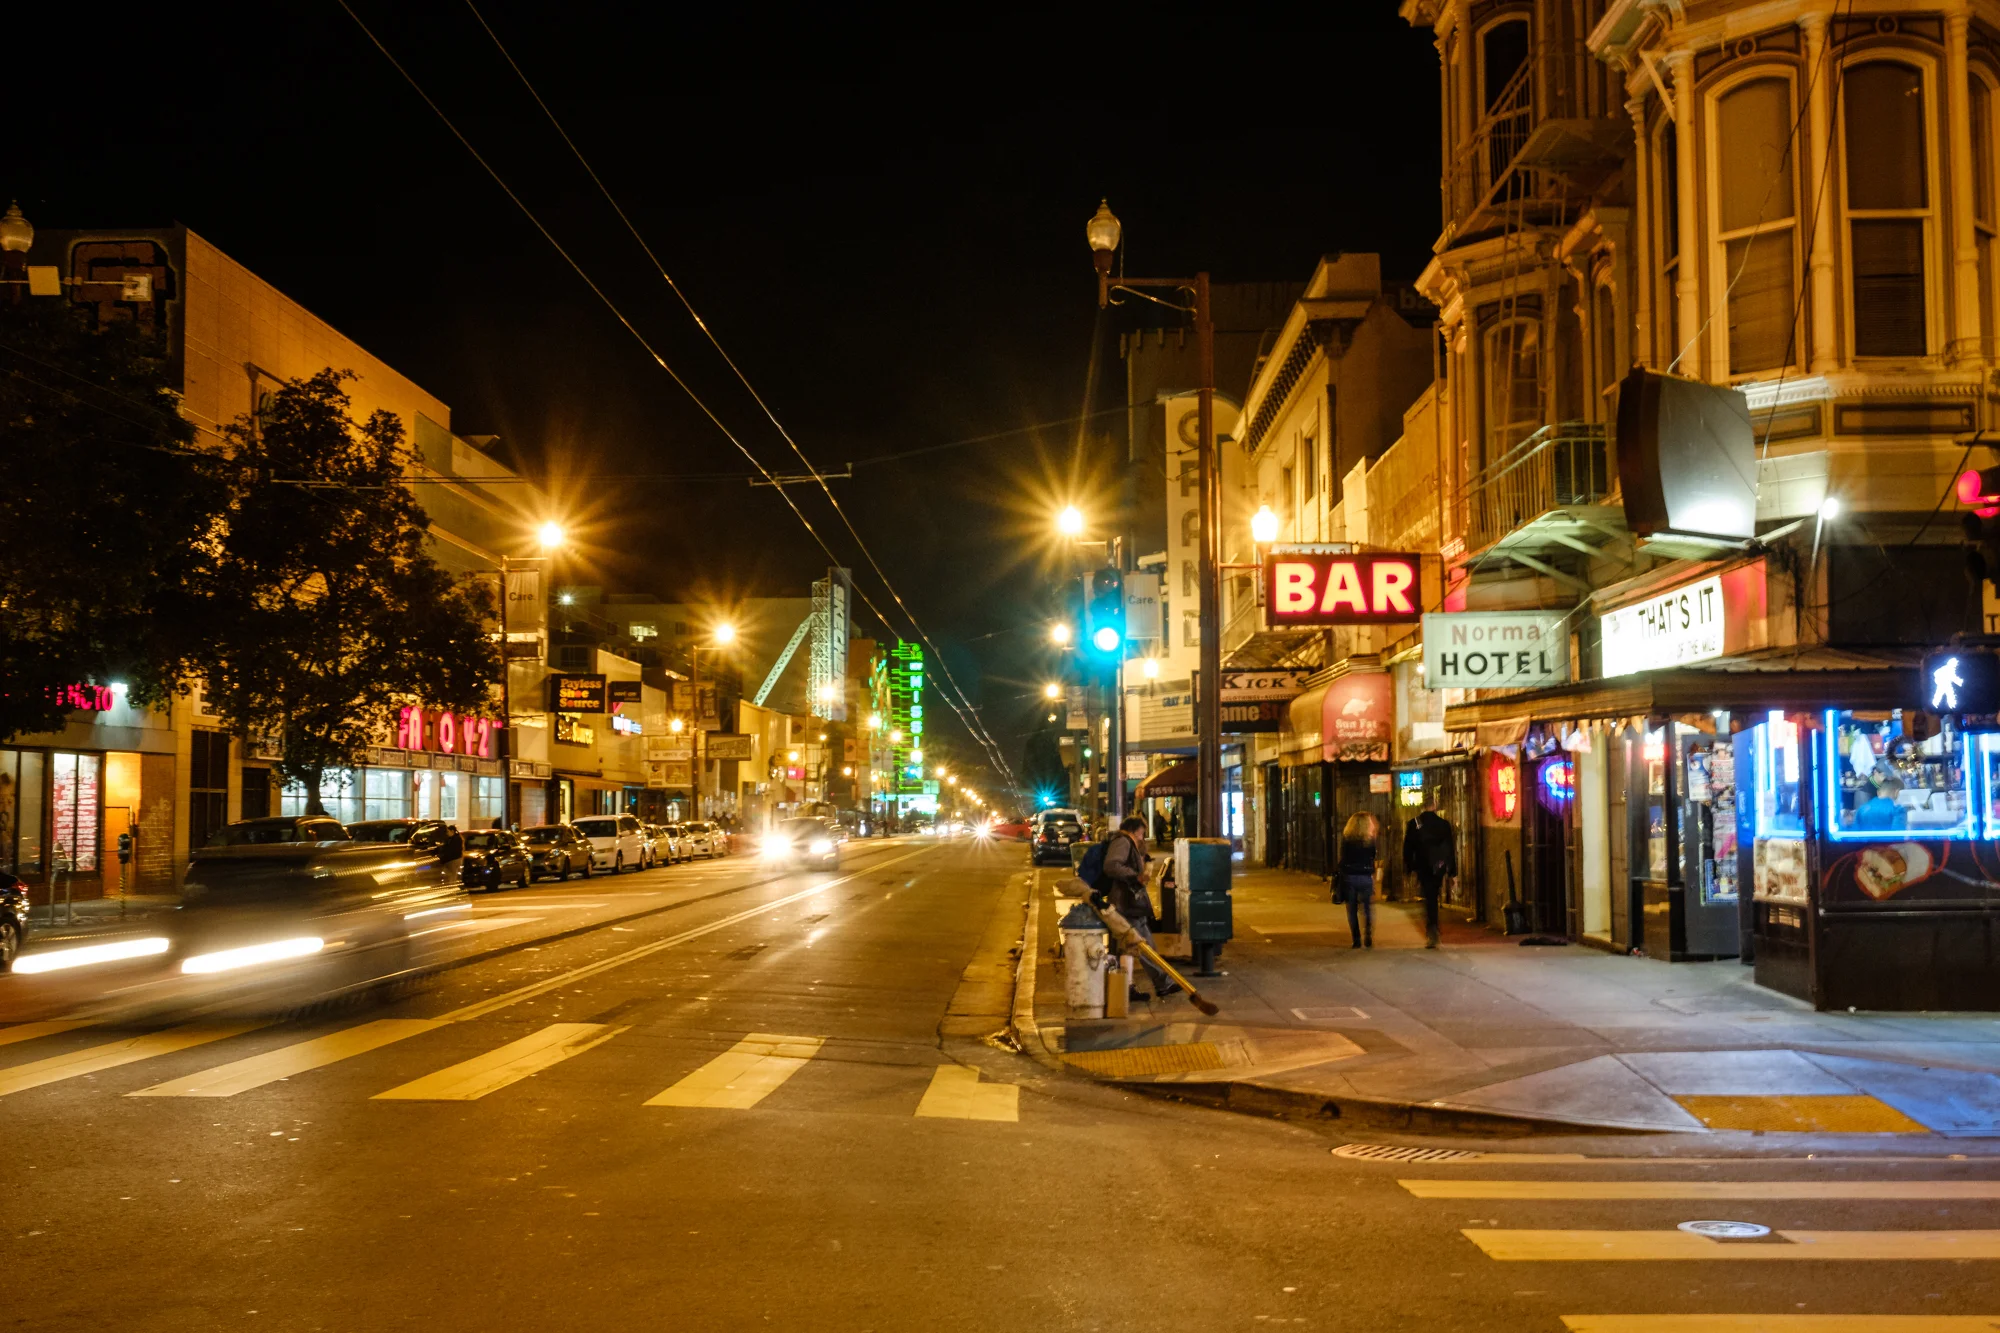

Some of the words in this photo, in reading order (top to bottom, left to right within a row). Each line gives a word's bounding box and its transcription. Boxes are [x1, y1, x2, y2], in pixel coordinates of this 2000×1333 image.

[1275, 561, 1415, 614] BAR
[1638, 594, 1691, 638] THAT'S
[1699, 586, 1714, 625] IT
[1451, 624, 1541, 646] Norma
[1440, 652, 1553, 676] HOTEL
[560, 678, 602, 690] Payless
[1220, 671, 1306, 690] KICK'S
[559, 688, 589, 698] Shoe
[559, 698, 600, 708] Source
